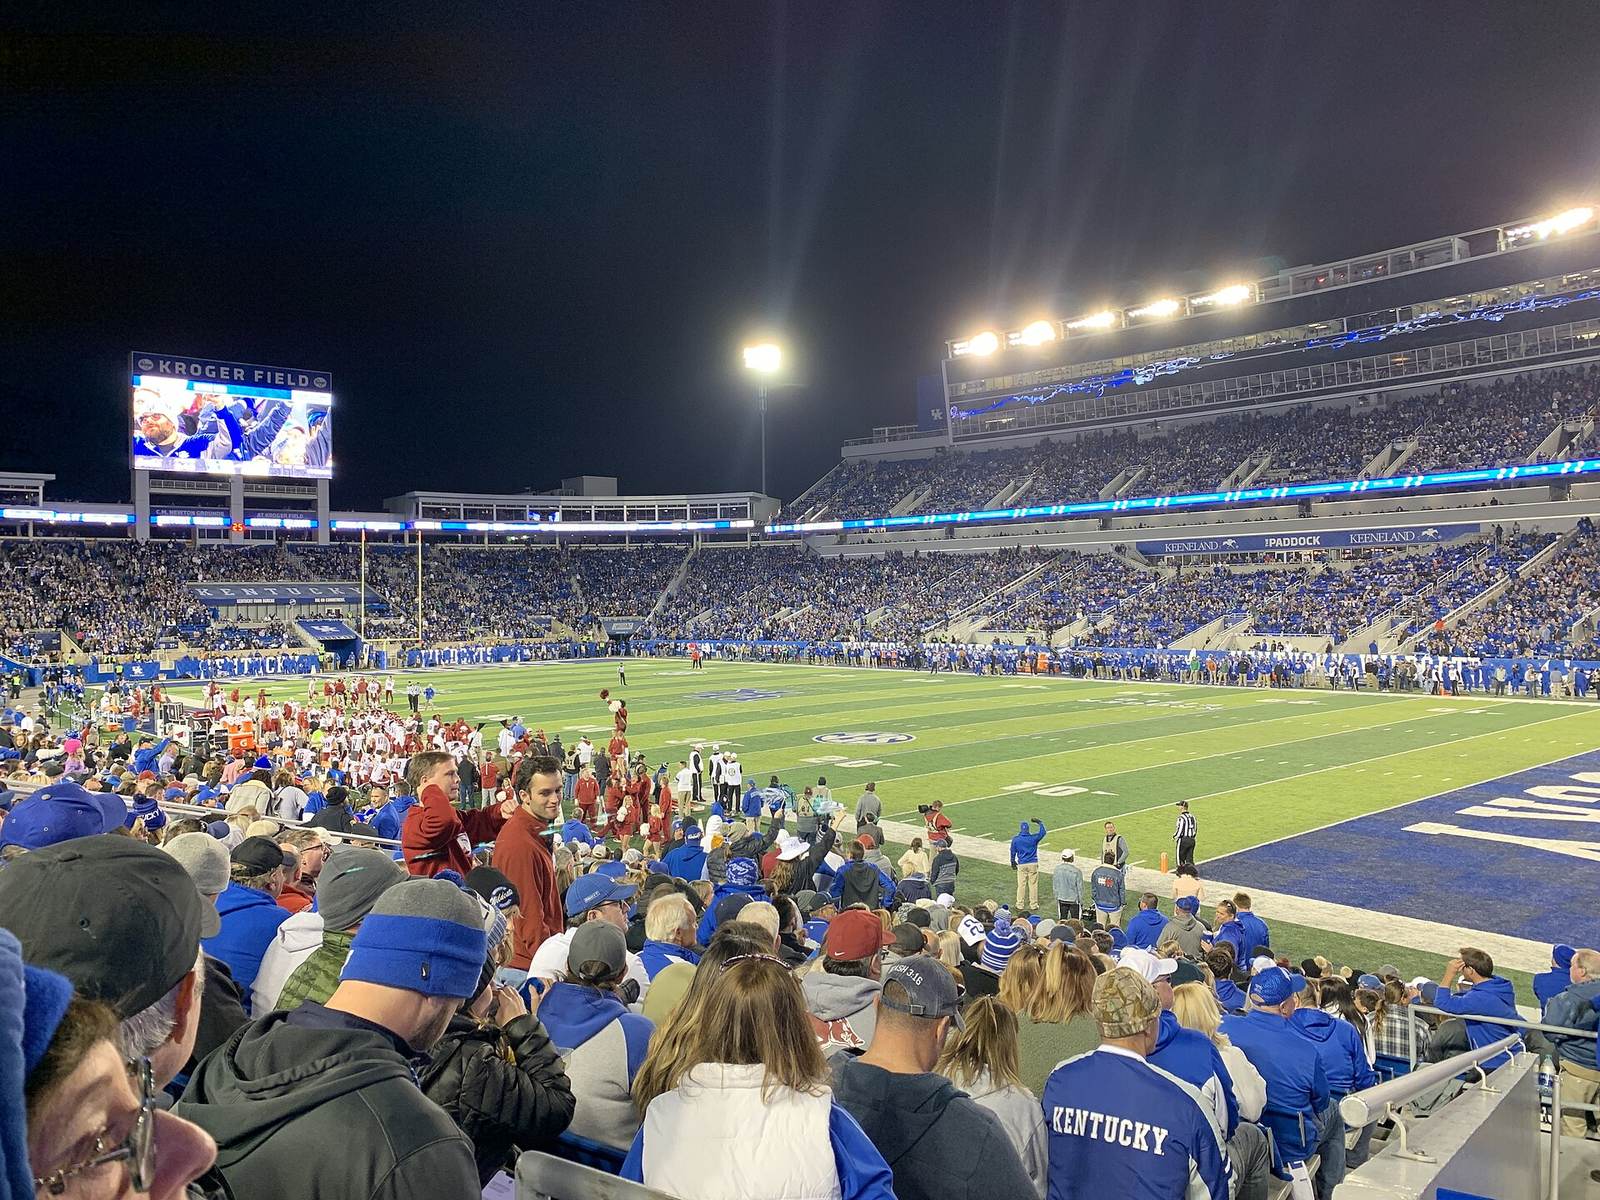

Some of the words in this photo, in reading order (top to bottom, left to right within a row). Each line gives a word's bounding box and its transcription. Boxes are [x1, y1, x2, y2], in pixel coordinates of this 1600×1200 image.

[159, 360, 245, 381] KROGER
[254, 370, 309, 387] FIELD
[232, 523, 243, 532] 25
[1269, 536, 1321, 547] PADDOCK
[1350, 531, 1415, 544] KEENELAND
[1165, 539, 1218, 552] KEENELAND
[196, 587, 363, 597] KENTUCKY
[906, 968, 924, 986] 3:16
[1053, 1106, 1169, 1156] KENTUCKY
